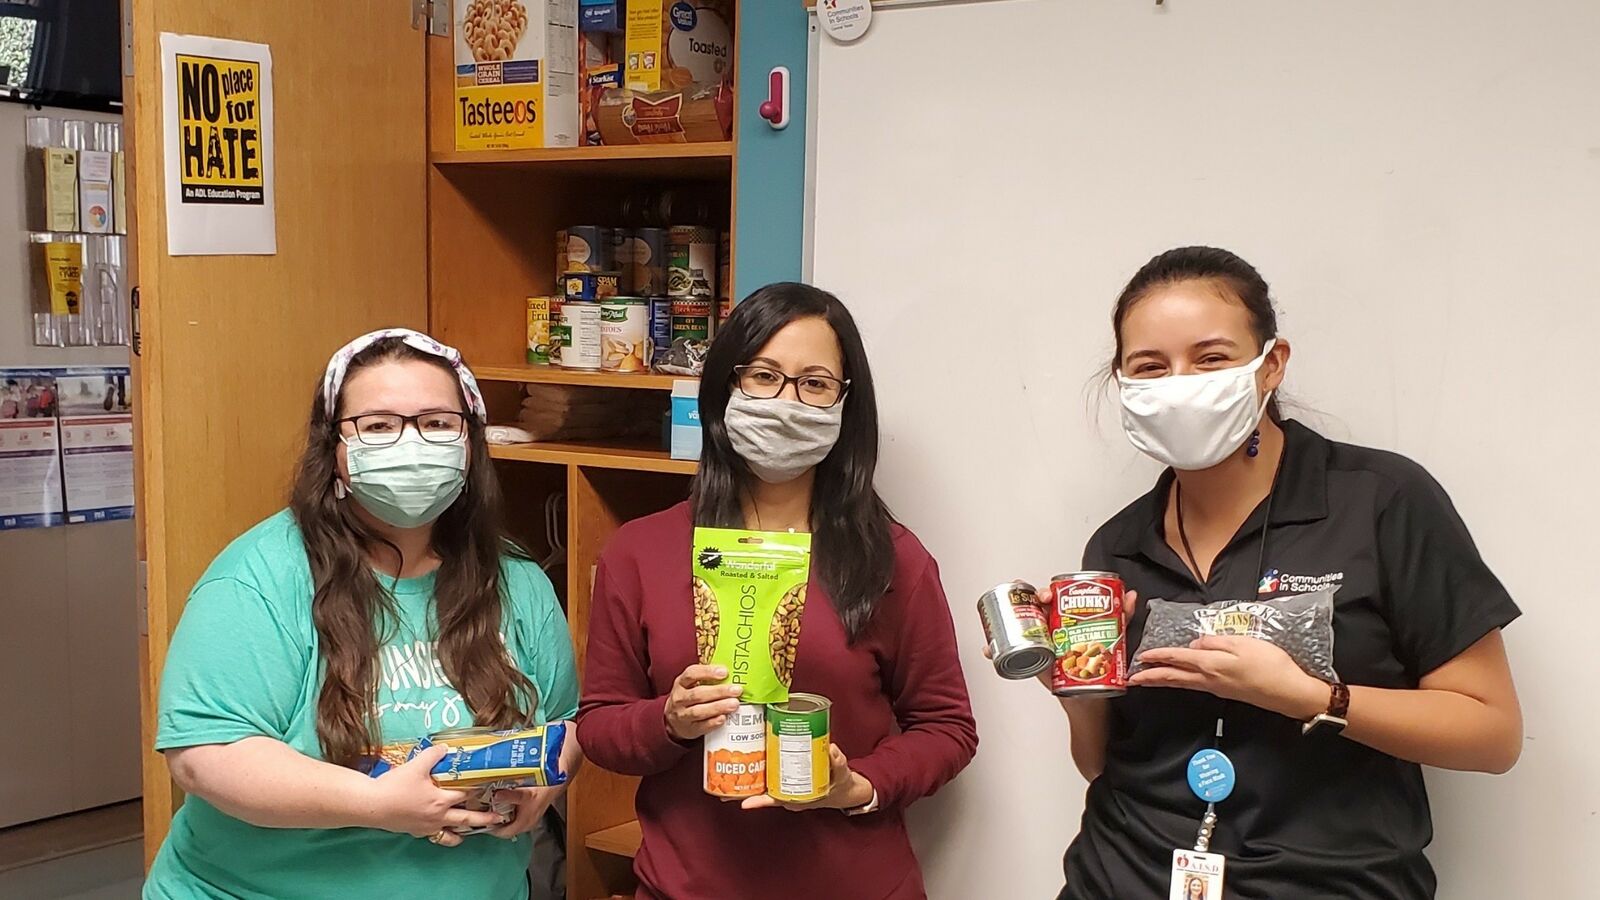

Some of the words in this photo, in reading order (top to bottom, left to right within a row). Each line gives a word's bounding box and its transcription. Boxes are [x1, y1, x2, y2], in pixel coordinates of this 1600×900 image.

[688, 37, 727, 58] Toasted
[478, 70, 501, 78] GRAIN
[181, 61, 221, 123] NO
[221, 66, 254, 100] place
[225, 99, 256, 125] for
[183, 125, 259, 180] HATE
[185, 187, 195, 198] An
[195, 188, 207, 198] ADL
[207, 188, 236, 199] Education
[236, 188, 261, 201] Program
[596, 276, 618, 287] SPAM
[531, 310, 548, 321] Fru
[720, 570, 748, 579] Roasted
[757, 572, 779, 580] Salted
[1280, 572, 1344, 584] Communities
[1060, 595, 1110, 611] CHUNKY
[732, 584, 758, 685] PISTACHIOS
[715, 761, 747, 775] DICED
